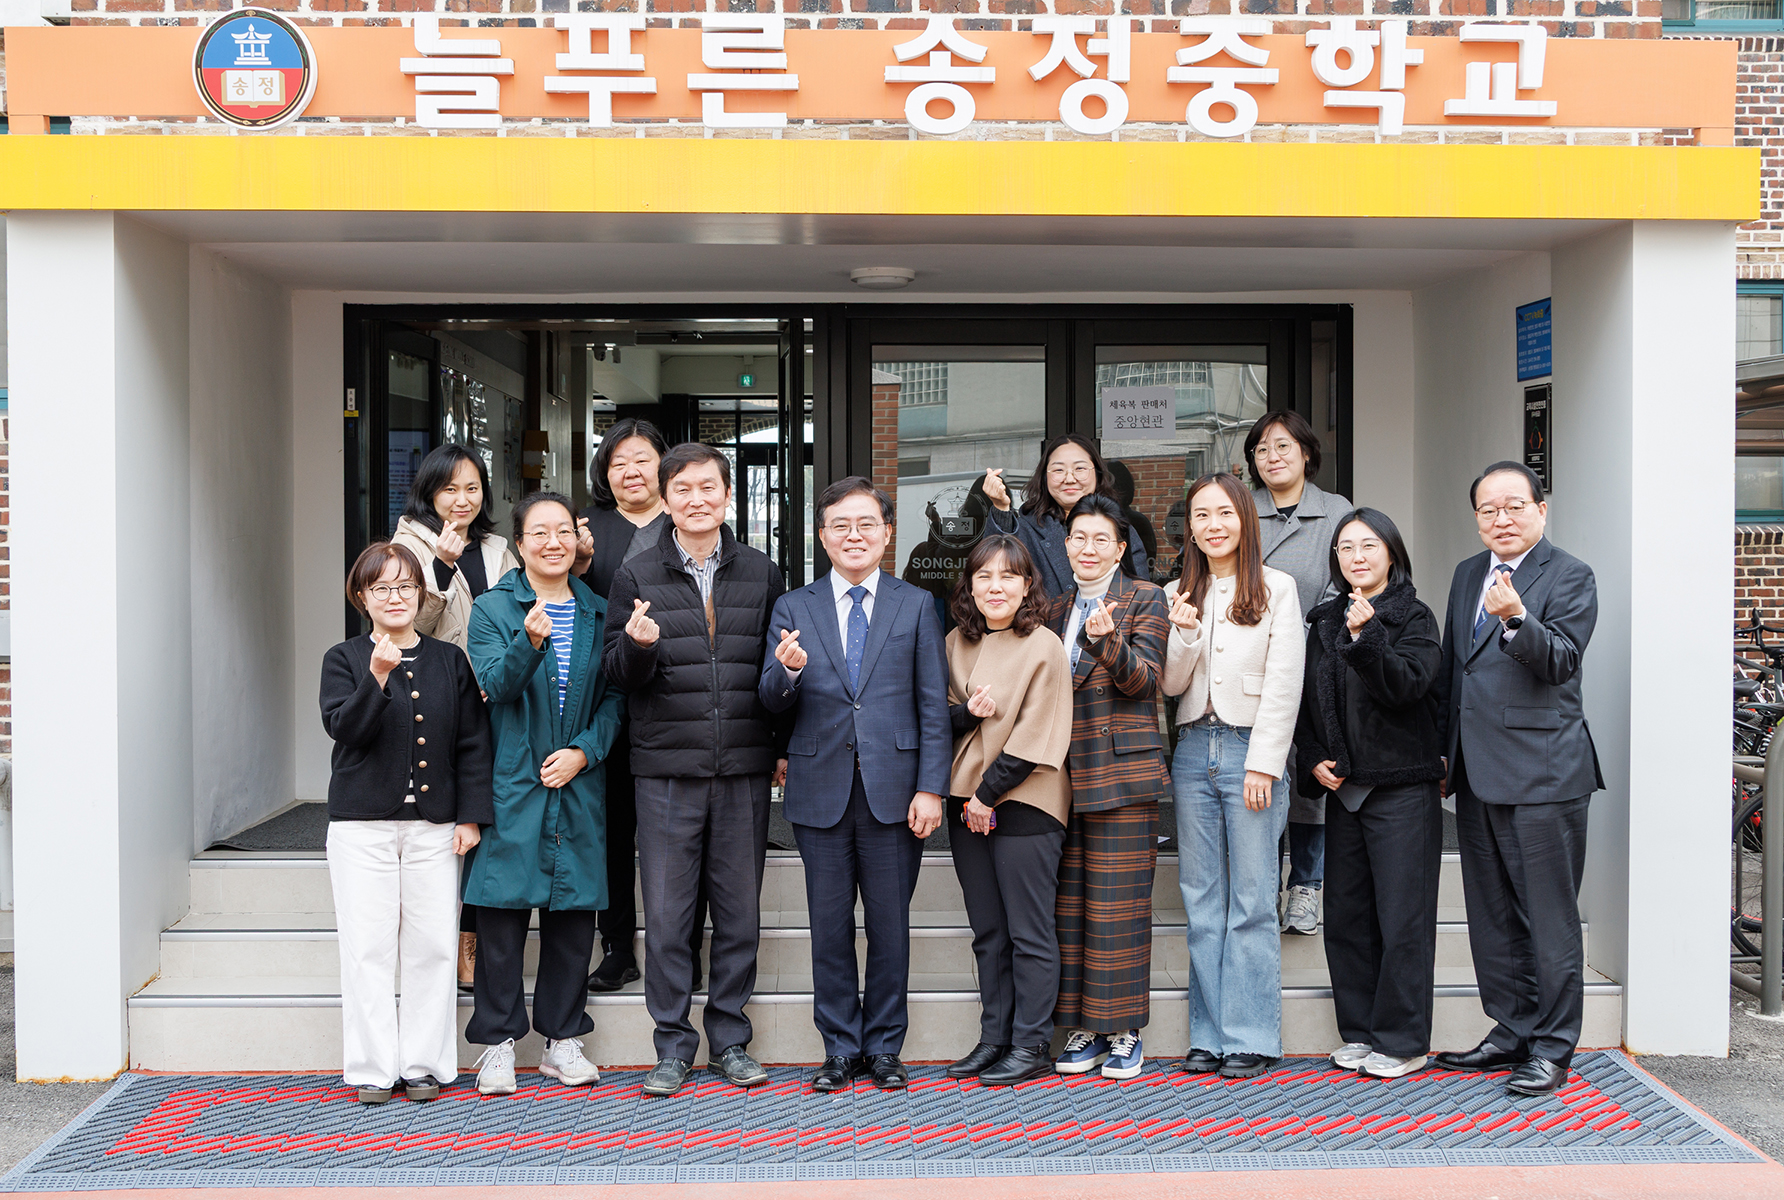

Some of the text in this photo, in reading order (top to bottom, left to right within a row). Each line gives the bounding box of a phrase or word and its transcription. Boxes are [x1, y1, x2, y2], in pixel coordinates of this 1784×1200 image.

[400, 12, 1557, 137] 늘푸른 송정중학교
[1109, 399, 1168, 409] 체육복 판매처
[1114, 414, 1164, 429] 중앙현관
[920, 571, 954, 579] MIDDLE
